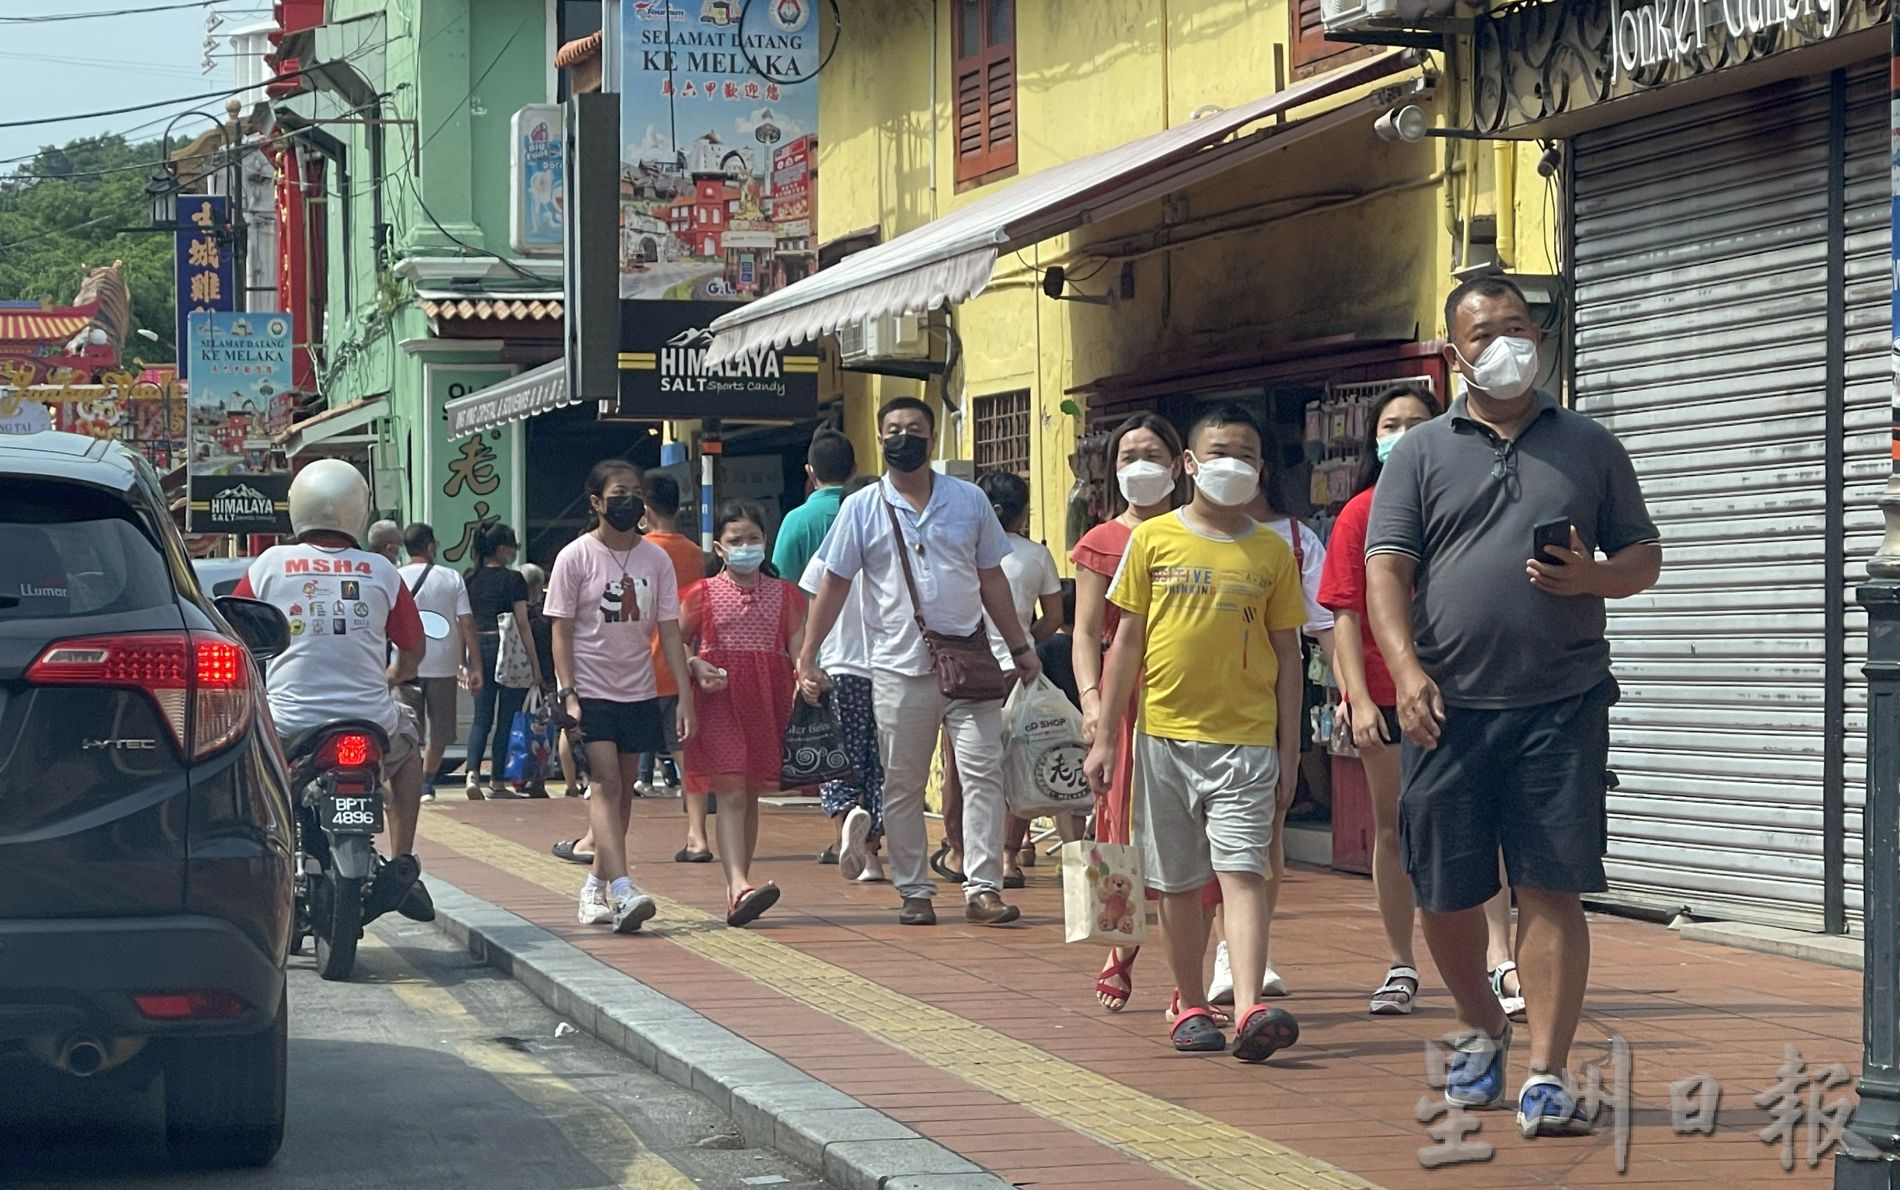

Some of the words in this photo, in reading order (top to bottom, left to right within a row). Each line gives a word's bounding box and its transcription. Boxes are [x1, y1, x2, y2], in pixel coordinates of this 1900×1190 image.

[641, 29, 726, 47] SELAMAT
[732, 34, 802, 50] DATANG
[643, 51, 678, 71] KE
[688, 52, 802, 76] MELAKA
[202, 350, 221, 361] KE
[225, 350, 284, 362] MELAKA
[661, 378, 706, 392] SALT
[212, 499, 273, 514] HIMALAYA
[212, 513, 235, 522] SALT
[285, 558, 373, 575] MSH4
[335, 797, 367, 811] BPT
[332, 811, 374, 825] 4896
